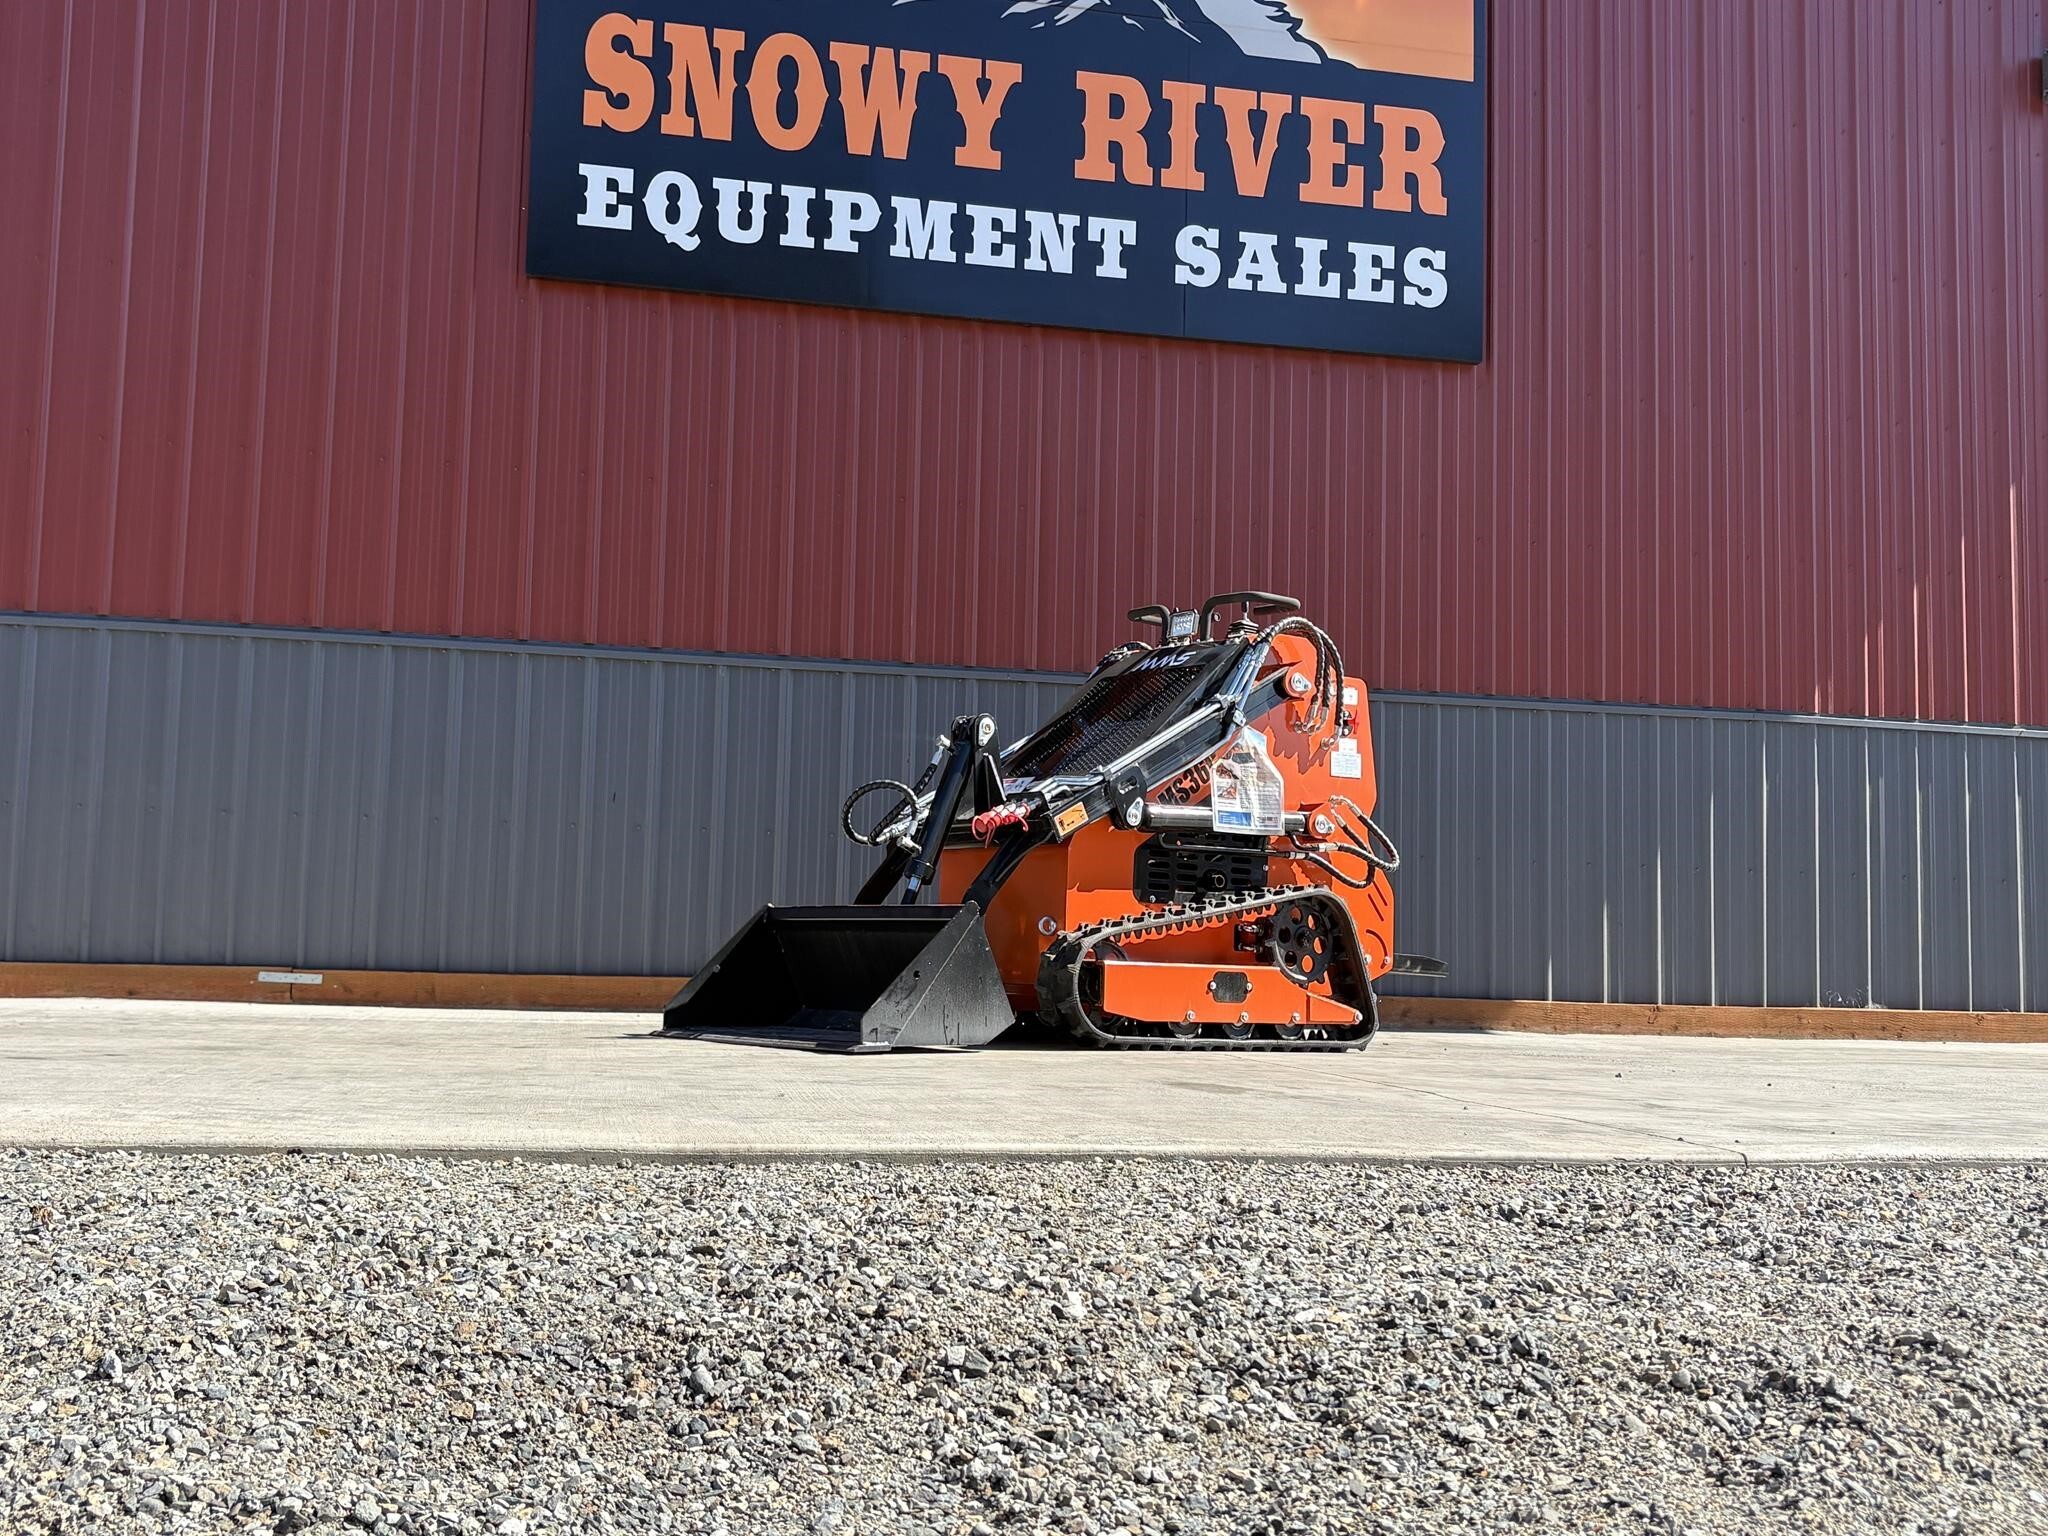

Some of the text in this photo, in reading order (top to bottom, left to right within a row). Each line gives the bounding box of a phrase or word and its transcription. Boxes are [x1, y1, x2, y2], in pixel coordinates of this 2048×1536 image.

[583, 13, 1447, 215] SNOWY RIVER
[577, 163, 1449, 309] EQUIPMENT SALES
